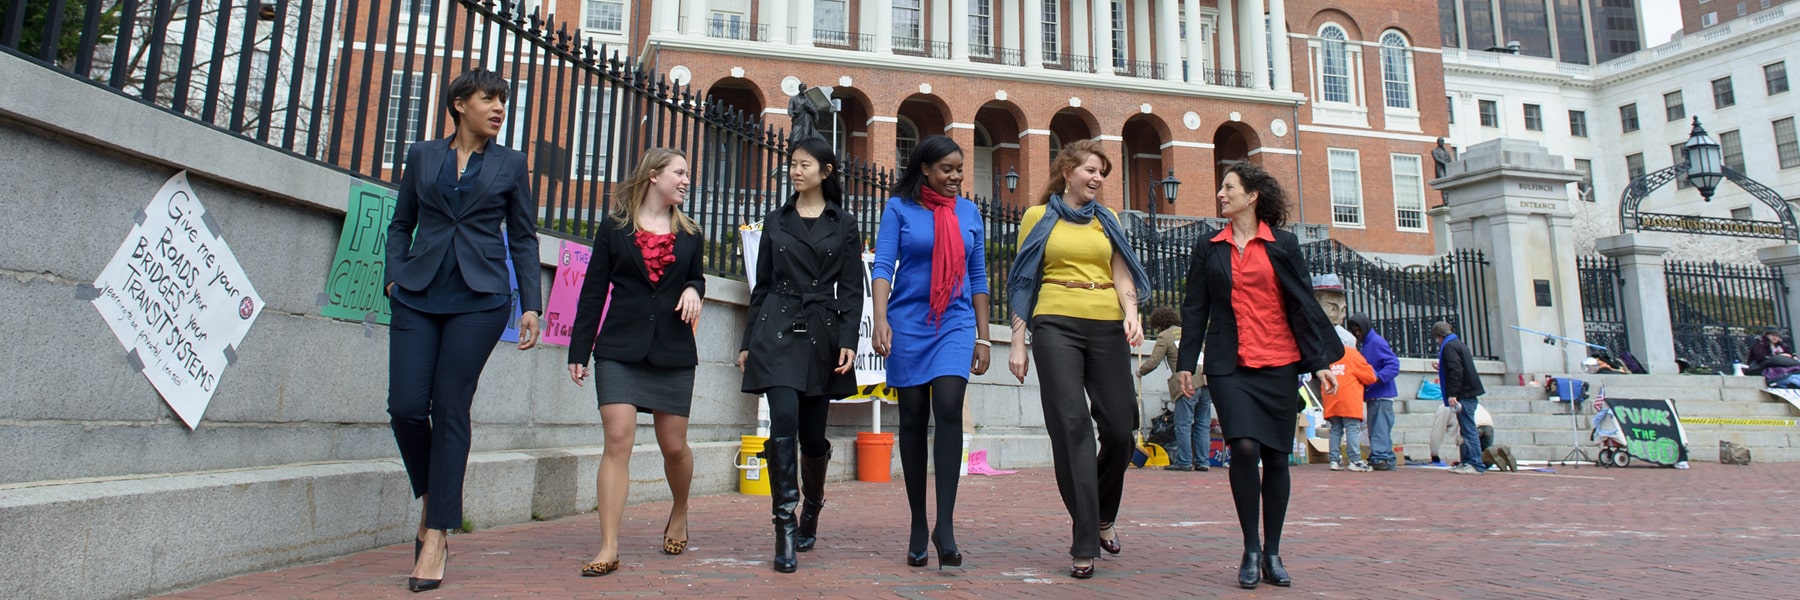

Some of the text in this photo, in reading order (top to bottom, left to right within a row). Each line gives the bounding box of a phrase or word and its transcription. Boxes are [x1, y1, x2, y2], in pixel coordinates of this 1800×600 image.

[1518, 183, 1554, 192] BULFINCH
[1519, 201, 1556, 210] ENTRANCE
[1723, 223, 1751, 233] STATE
[1753, 225, 1783, 235] HOUSE
[167, 190, 240, 298] Give me your
[187, 287, 208, 311] your
[121, 263, 216, 393] TRANSIT SYSTEMS
[183, 313, 207, 341] your
[1614, 406, 1671, 426] FUNK
[1632, 428, 1656, 440] THE
